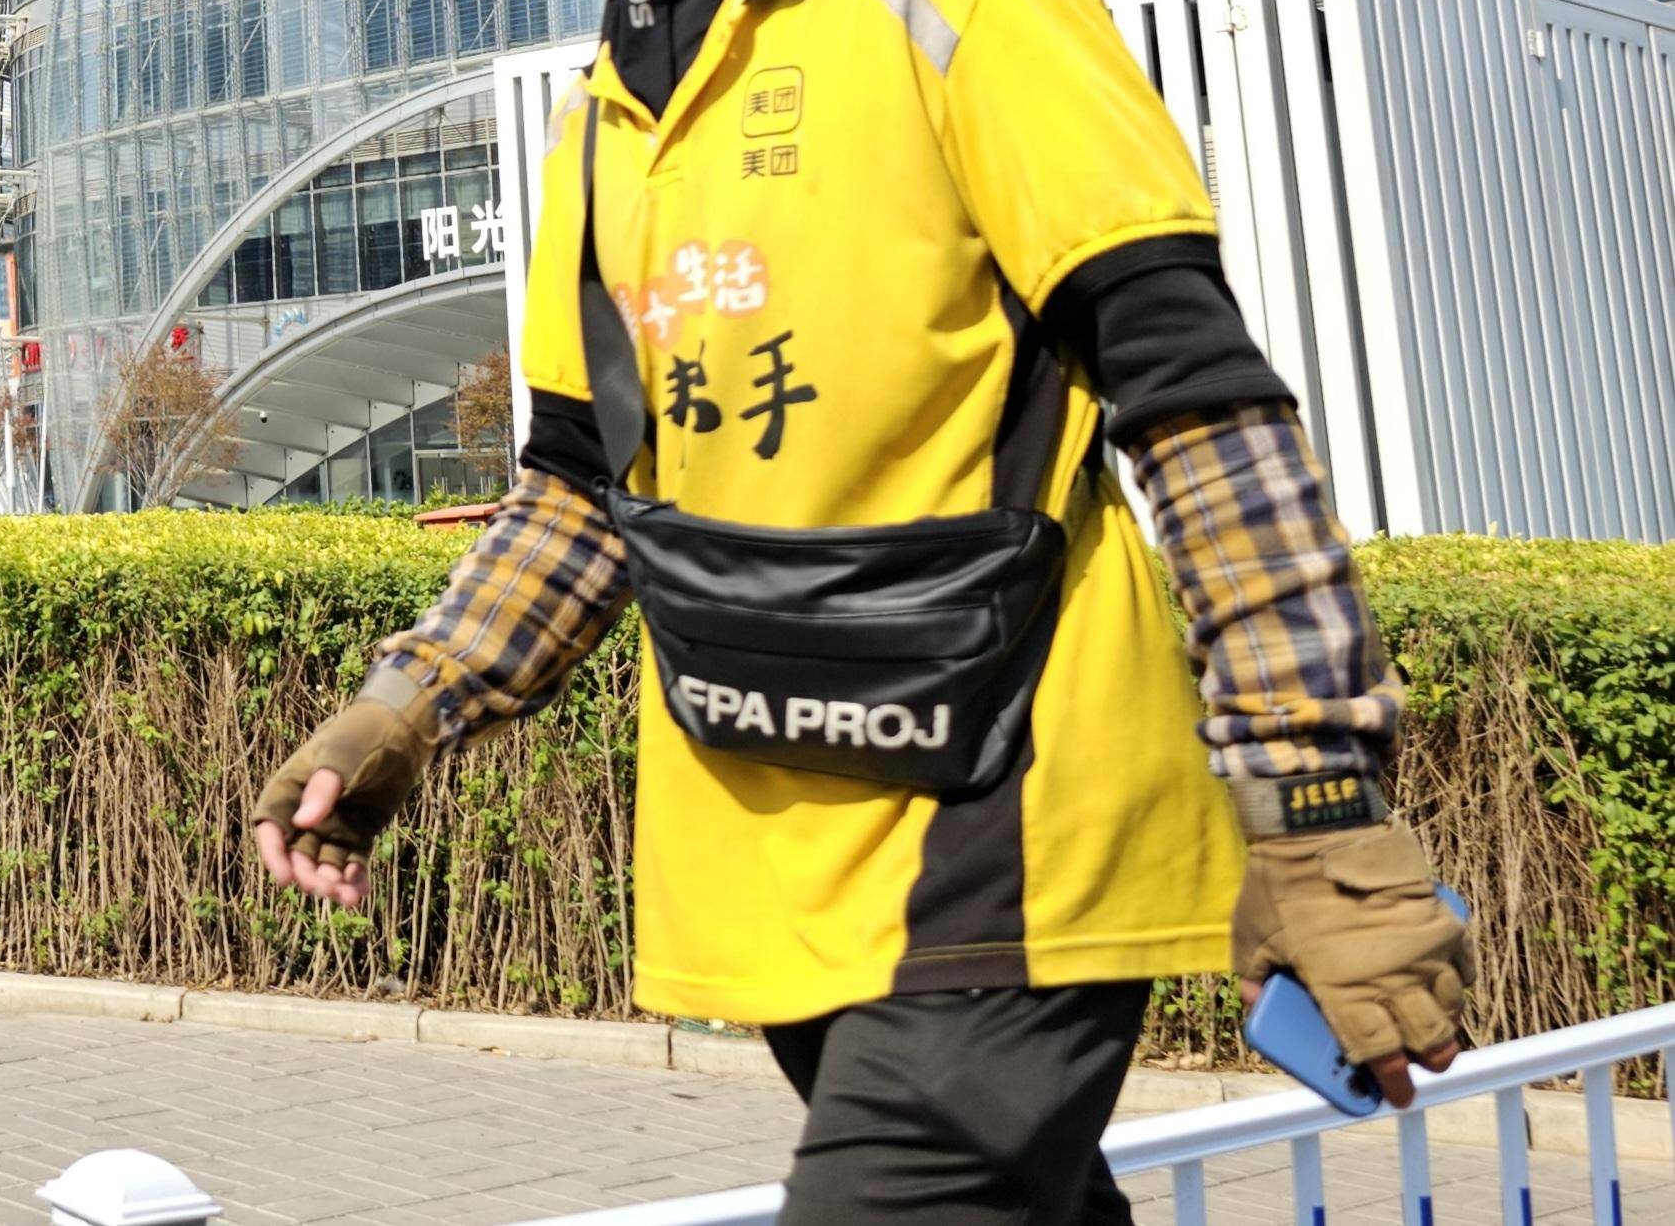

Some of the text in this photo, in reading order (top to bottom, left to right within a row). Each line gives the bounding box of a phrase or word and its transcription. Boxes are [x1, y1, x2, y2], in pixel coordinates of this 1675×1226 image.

[747, 85, 796, 117] 美团
[741, 144, 798, 180] 美团
[421, 200, 505, 261] 阳光
[785, 696, 950, 749] PROJ
